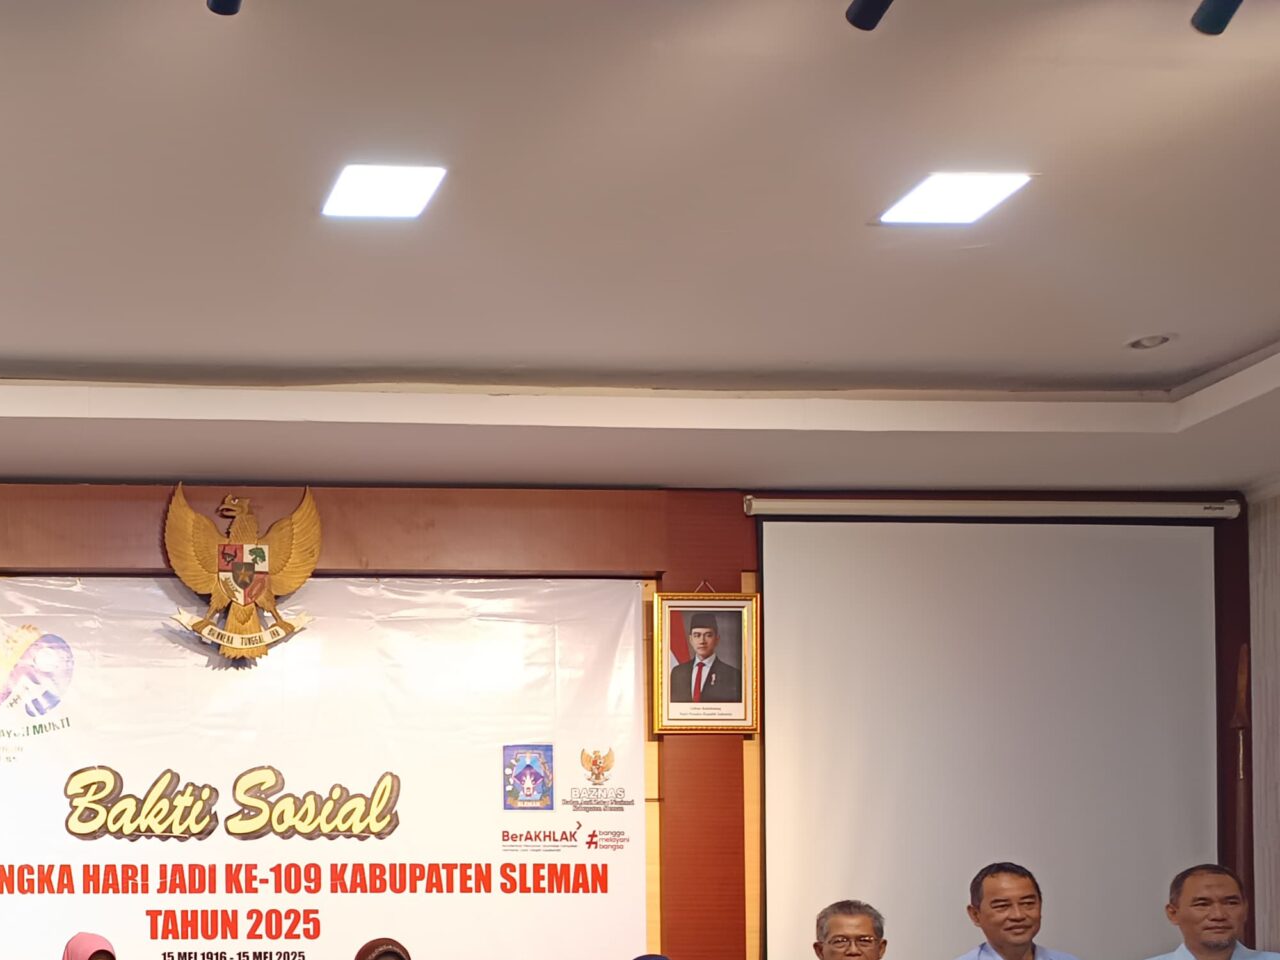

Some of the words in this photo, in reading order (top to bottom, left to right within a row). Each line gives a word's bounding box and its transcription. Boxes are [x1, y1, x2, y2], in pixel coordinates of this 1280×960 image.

[64, 765, 220, 842] Bakti
[224, 765, 401, 840] Sosial
[571, 787, 626, 799] BAZNAS
[502, 830, 578, 842] BerAKHLAK
[82, 864, 149, 894] HARI
[157, 864, 216, 894] JADI
[225, 863, 322, 894] KE-109
[330, 863, 492, 894] KABUPATEN
[499, 863, 608, 893] SLEMAN
[146, 909, 238, 940] TAHUN
[246, 908, 320, 940] 2025
